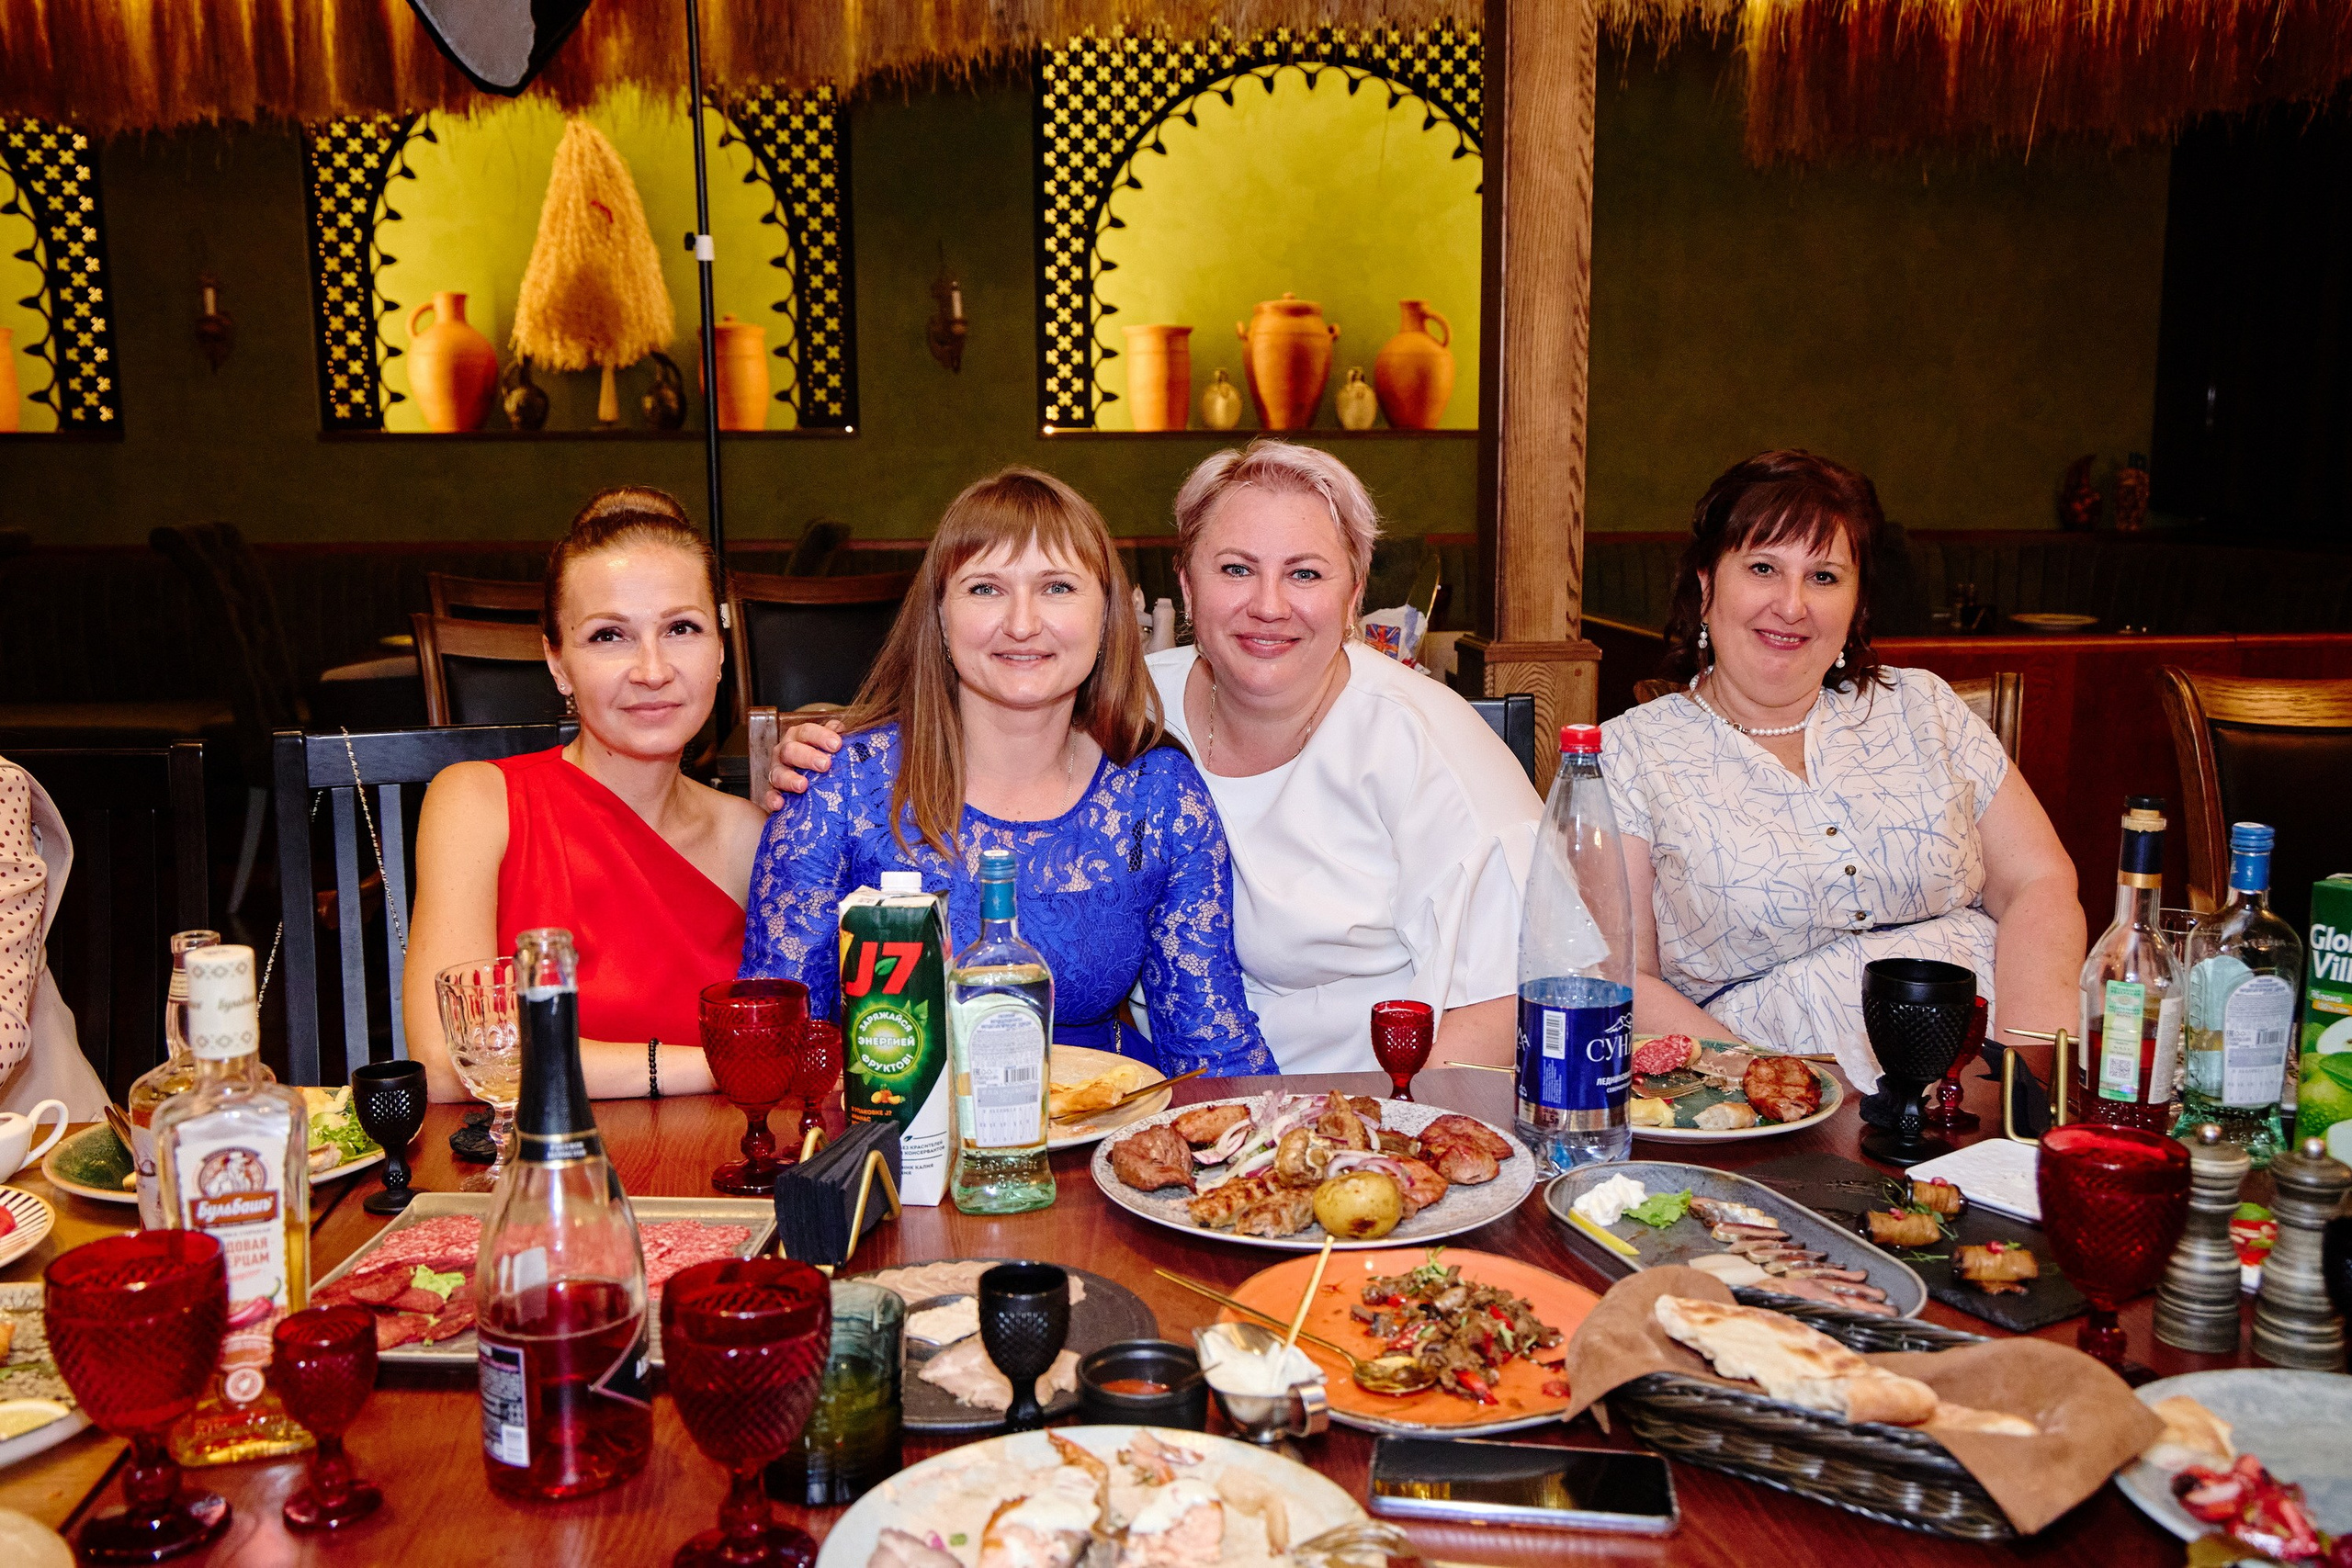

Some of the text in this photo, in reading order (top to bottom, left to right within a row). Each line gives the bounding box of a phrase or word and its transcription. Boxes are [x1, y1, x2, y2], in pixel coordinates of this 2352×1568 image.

[2310, 923, 2352, 953] Glo
[845, 941, 923, 998] J7
[859, 1010, 913, 1032] ЗАРЯЖАЙСЯ
[857, 1034, 915, 1047] ЭНЕРГИЕЙ
